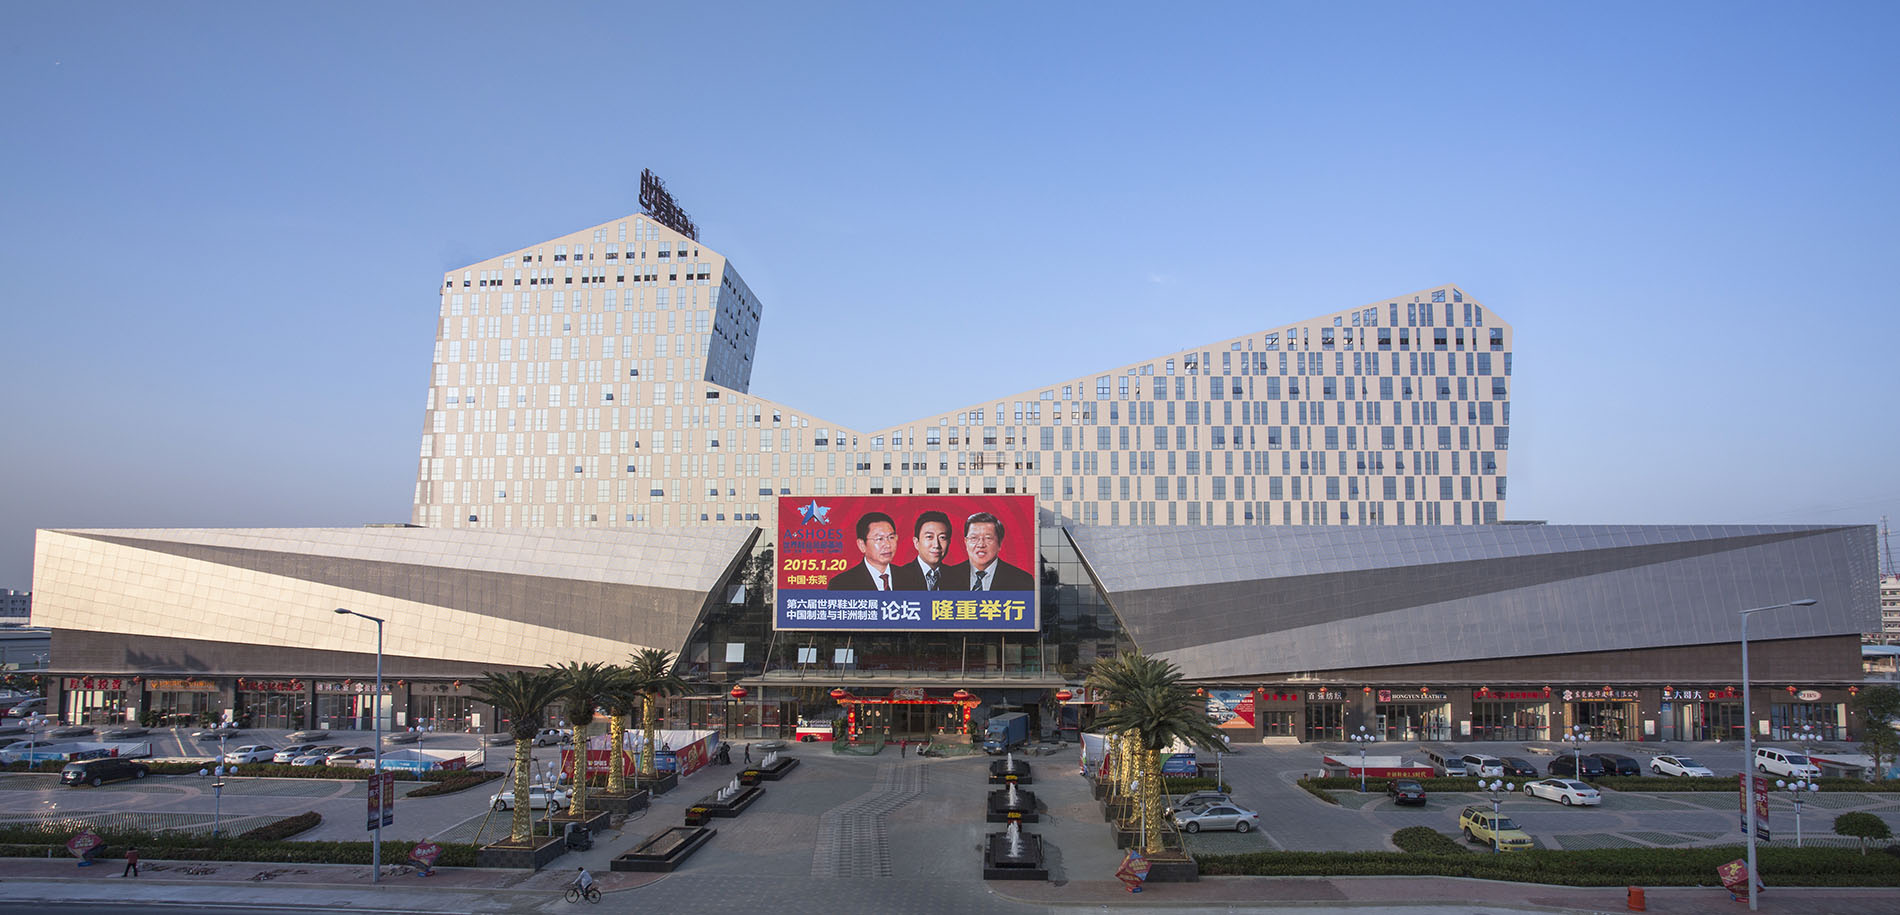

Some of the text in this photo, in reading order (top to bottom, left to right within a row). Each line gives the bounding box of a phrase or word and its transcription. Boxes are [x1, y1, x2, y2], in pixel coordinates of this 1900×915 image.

[783, 559, 847, 571] 2015.1.20
[787, 575, 827, 585] 中国·东莞
[786, 599, 878, 610] 第六届世界鞋业发展
[786, 610, 878, 621] 中国制造与非洲制造
[880, 600, 1026, 621] 论坛 隆重举行
[1673, 691, 1702, 700] 大哥大
